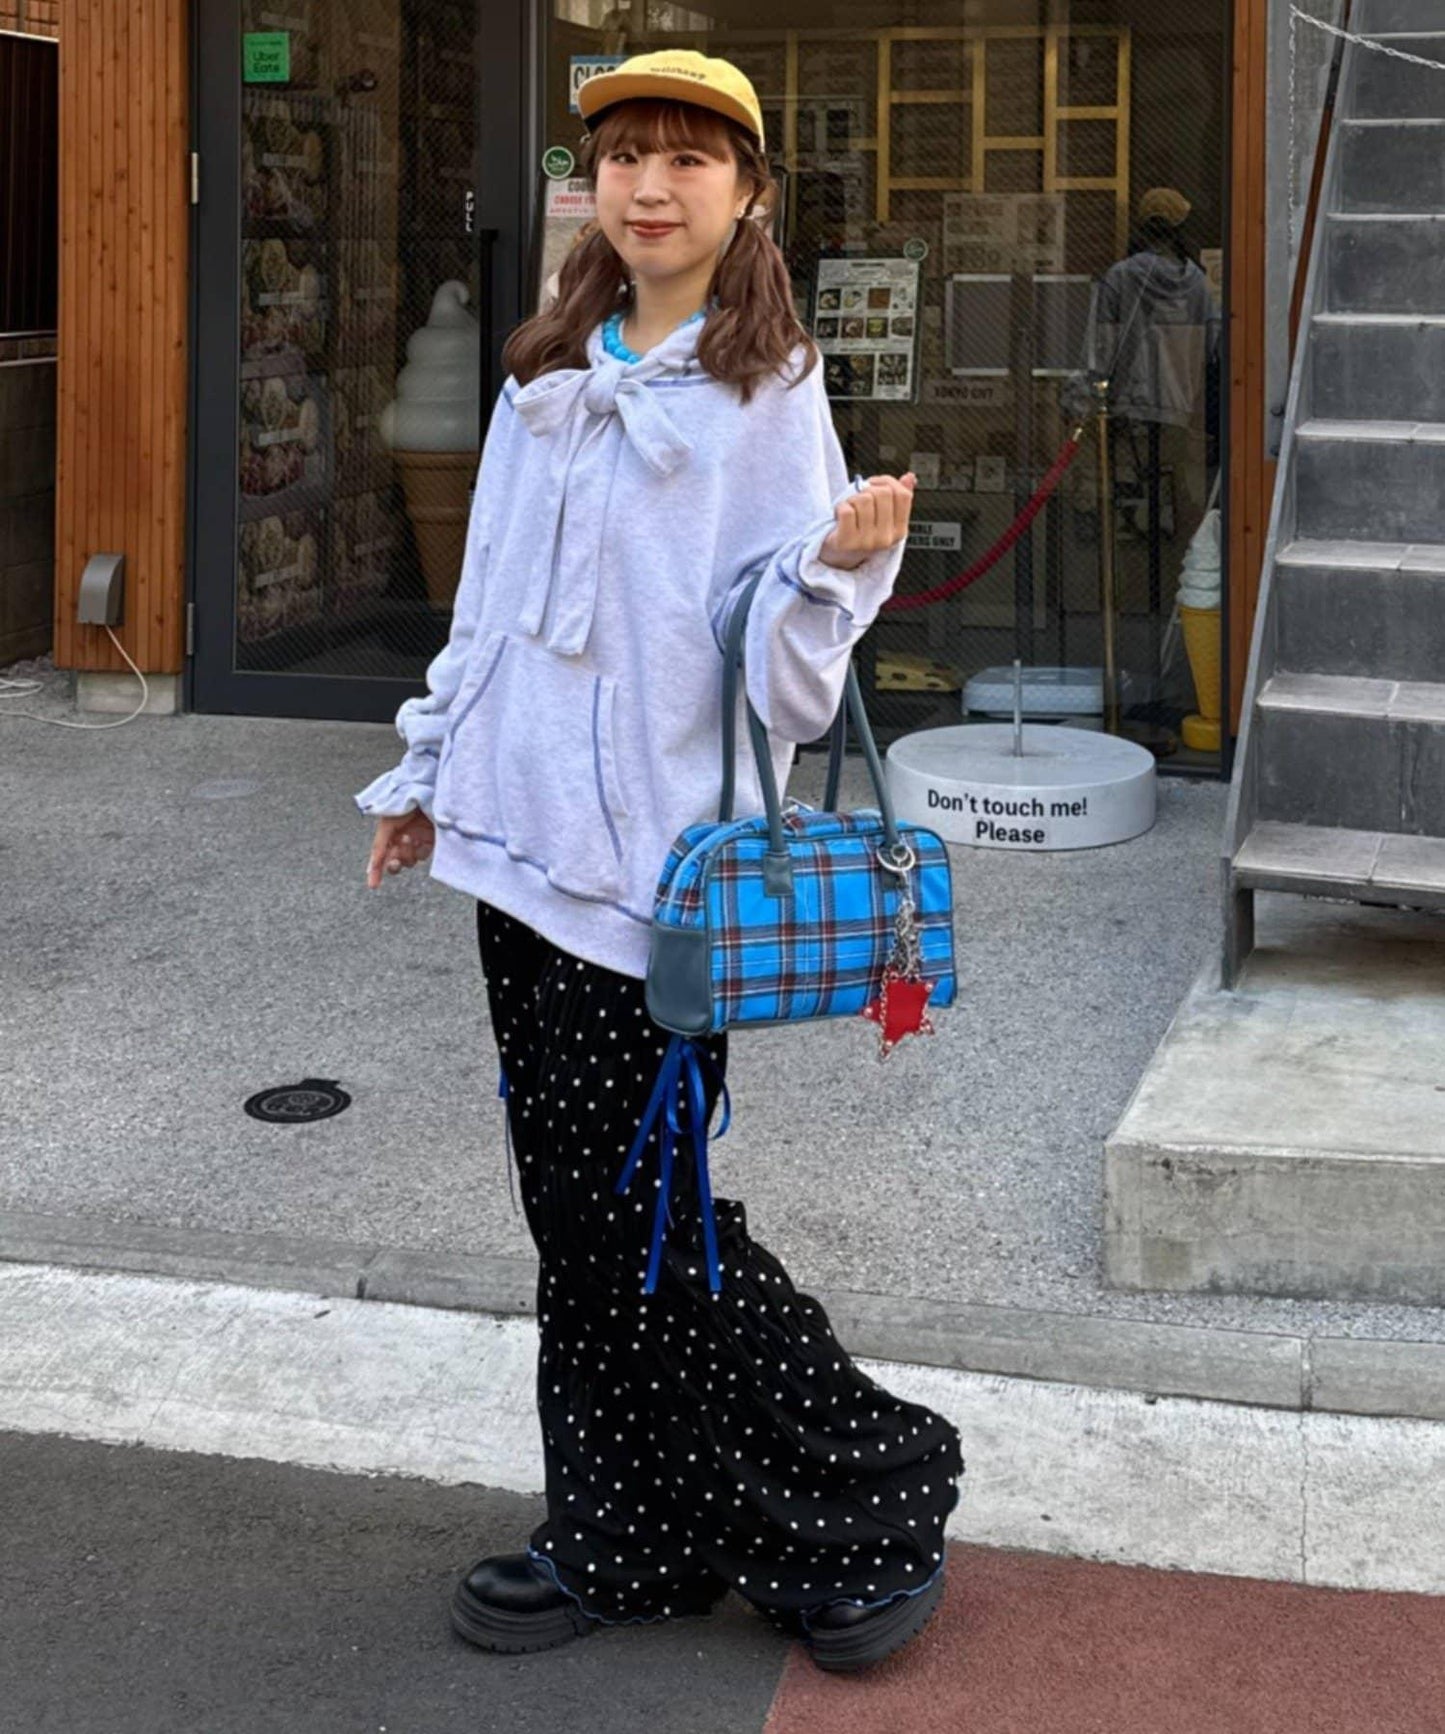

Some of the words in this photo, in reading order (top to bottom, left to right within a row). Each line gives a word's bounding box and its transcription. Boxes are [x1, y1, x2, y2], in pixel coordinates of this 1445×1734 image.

[252, 51, 280, 61] Uber
[252, 63, 280, 73] Eats
[465, 191, 474, 232] PULL
[928, 789, 977, 813] Don't
[984, 797, 1044, 817] touch
[1050, 797, 1087, 817] me!
[975, 820, 1045, 843] Please
